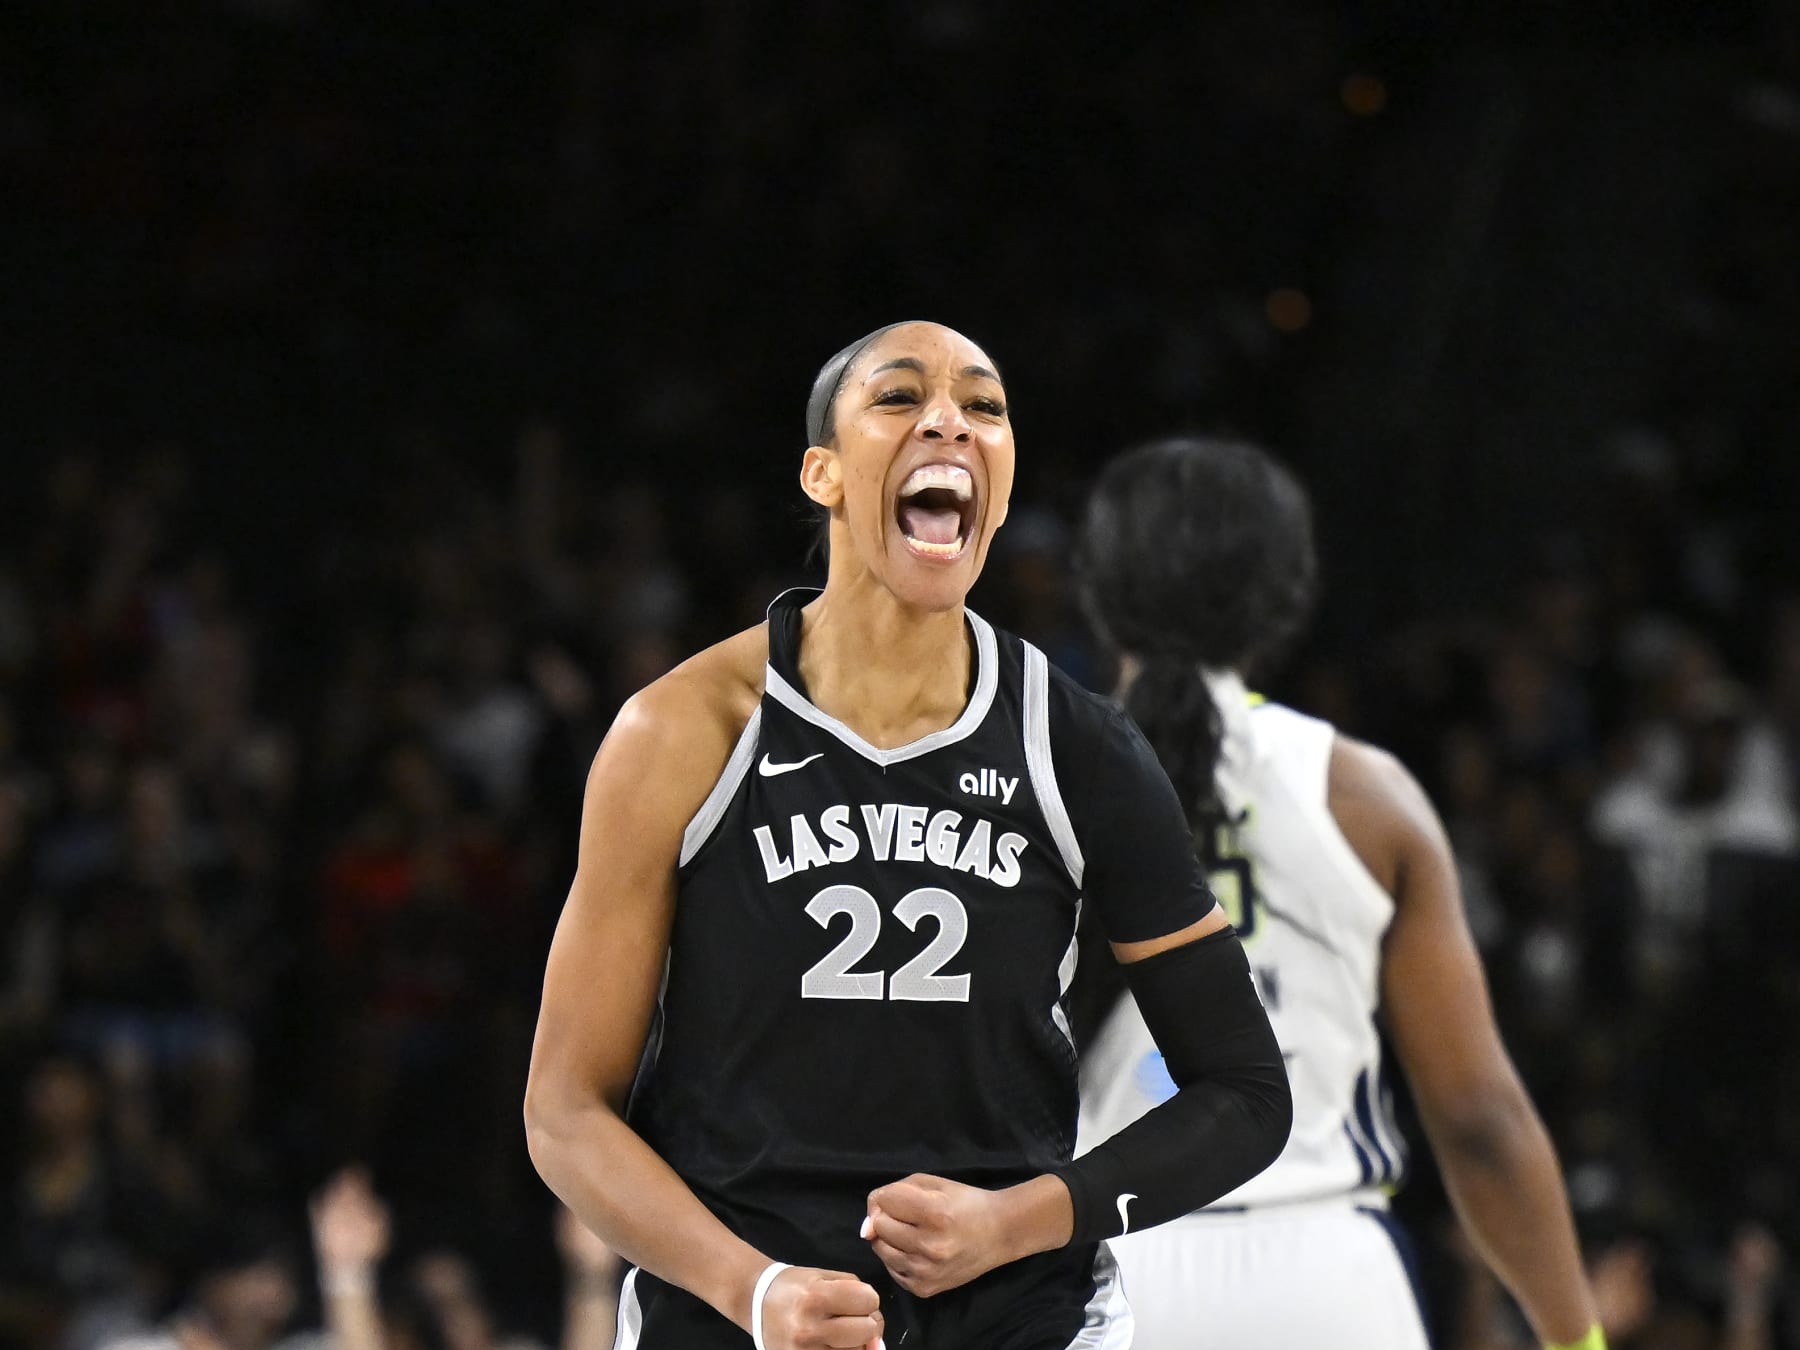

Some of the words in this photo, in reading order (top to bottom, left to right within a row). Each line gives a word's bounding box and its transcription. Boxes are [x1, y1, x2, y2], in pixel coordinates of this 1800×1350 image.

[959, 768, 1020, 805] ally
[753, 804, 860, 884] LAS
[860, 803, 1029, 888] VEGAS
[801, 884, 971, 1002] 22
